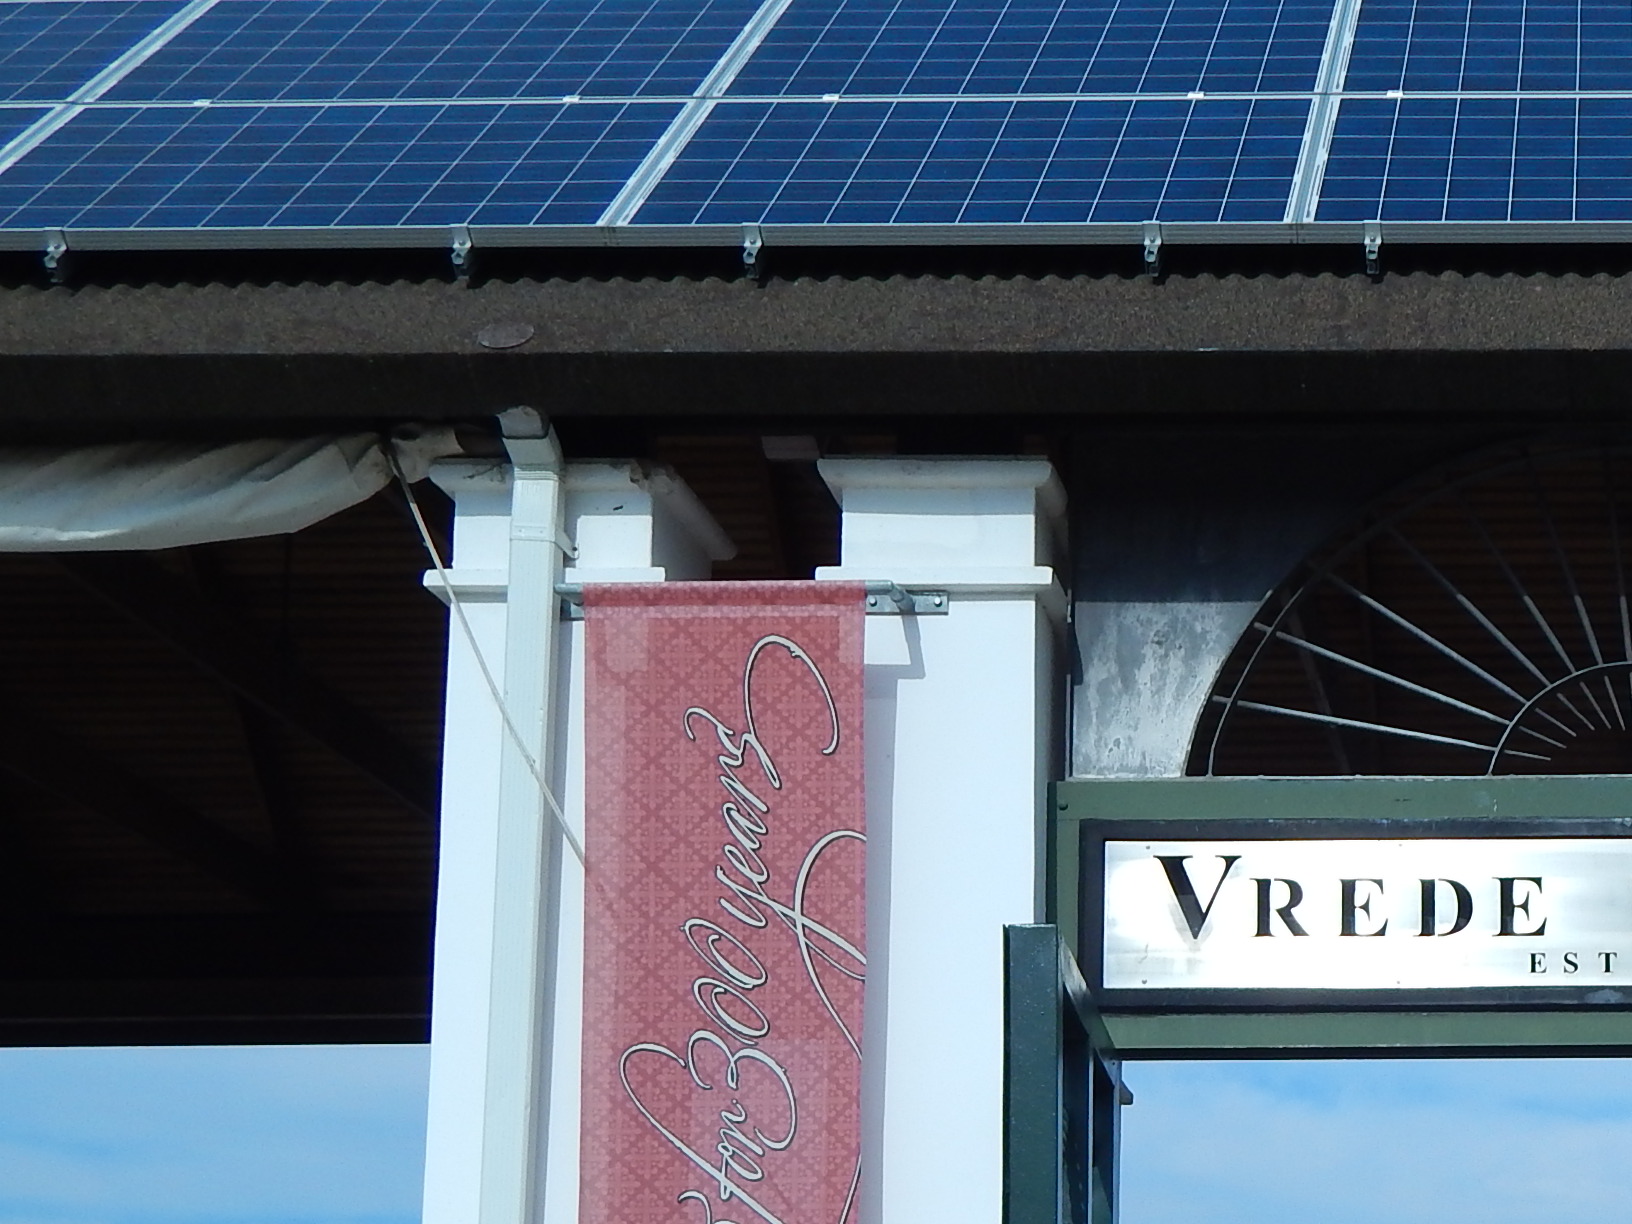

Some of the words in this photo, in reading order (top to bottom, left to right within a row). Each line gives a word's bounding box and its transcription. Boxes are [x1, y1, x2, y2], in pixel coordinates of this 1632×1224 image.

[682, 633, 867, 980] years
[1152, 853, 1551, 941] VREDE
[1529, 951, 1619, 976] EST
[680, 916, 798, 1150] 300
